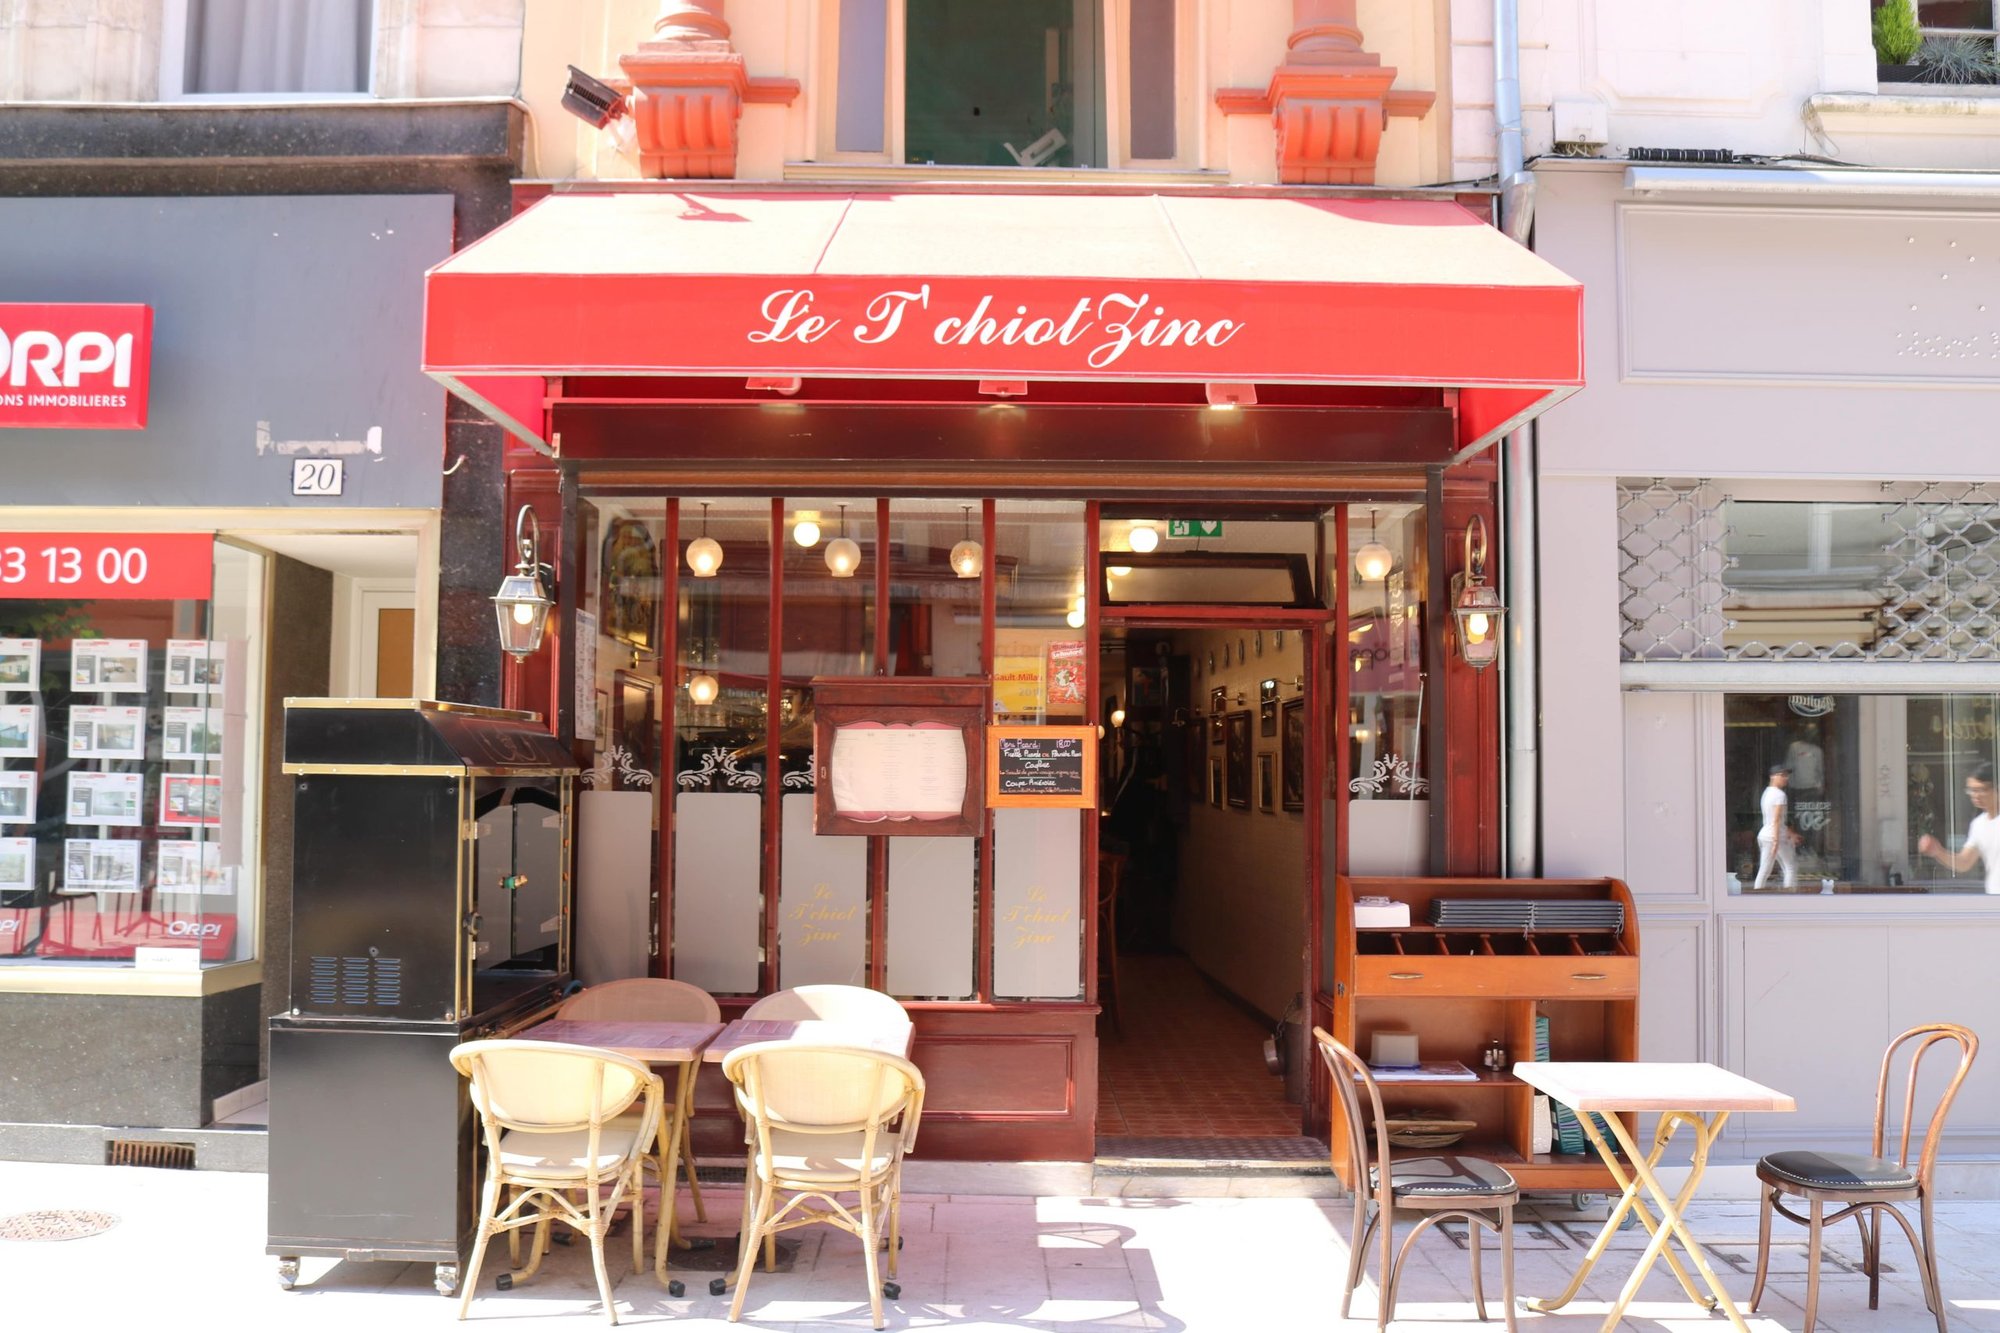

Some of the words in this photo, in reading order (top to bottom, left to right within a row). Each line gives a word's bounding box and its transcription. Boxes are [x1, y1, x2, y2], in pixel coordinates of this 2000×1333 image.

[747, 289, 841, 343] Le
[1088, 292, 1246, 368] Zinc
[0, 327, 133, 388] RPI
[28, 394, 127, 407] IMMOBILIERES
[297, 463, 335, 490] 20
[0, 546, 26, 583] 3
[41, 547, 82, 583] 13
[96, 547, 148, 584] 00
[168, 920, 222, 936] ORPI
